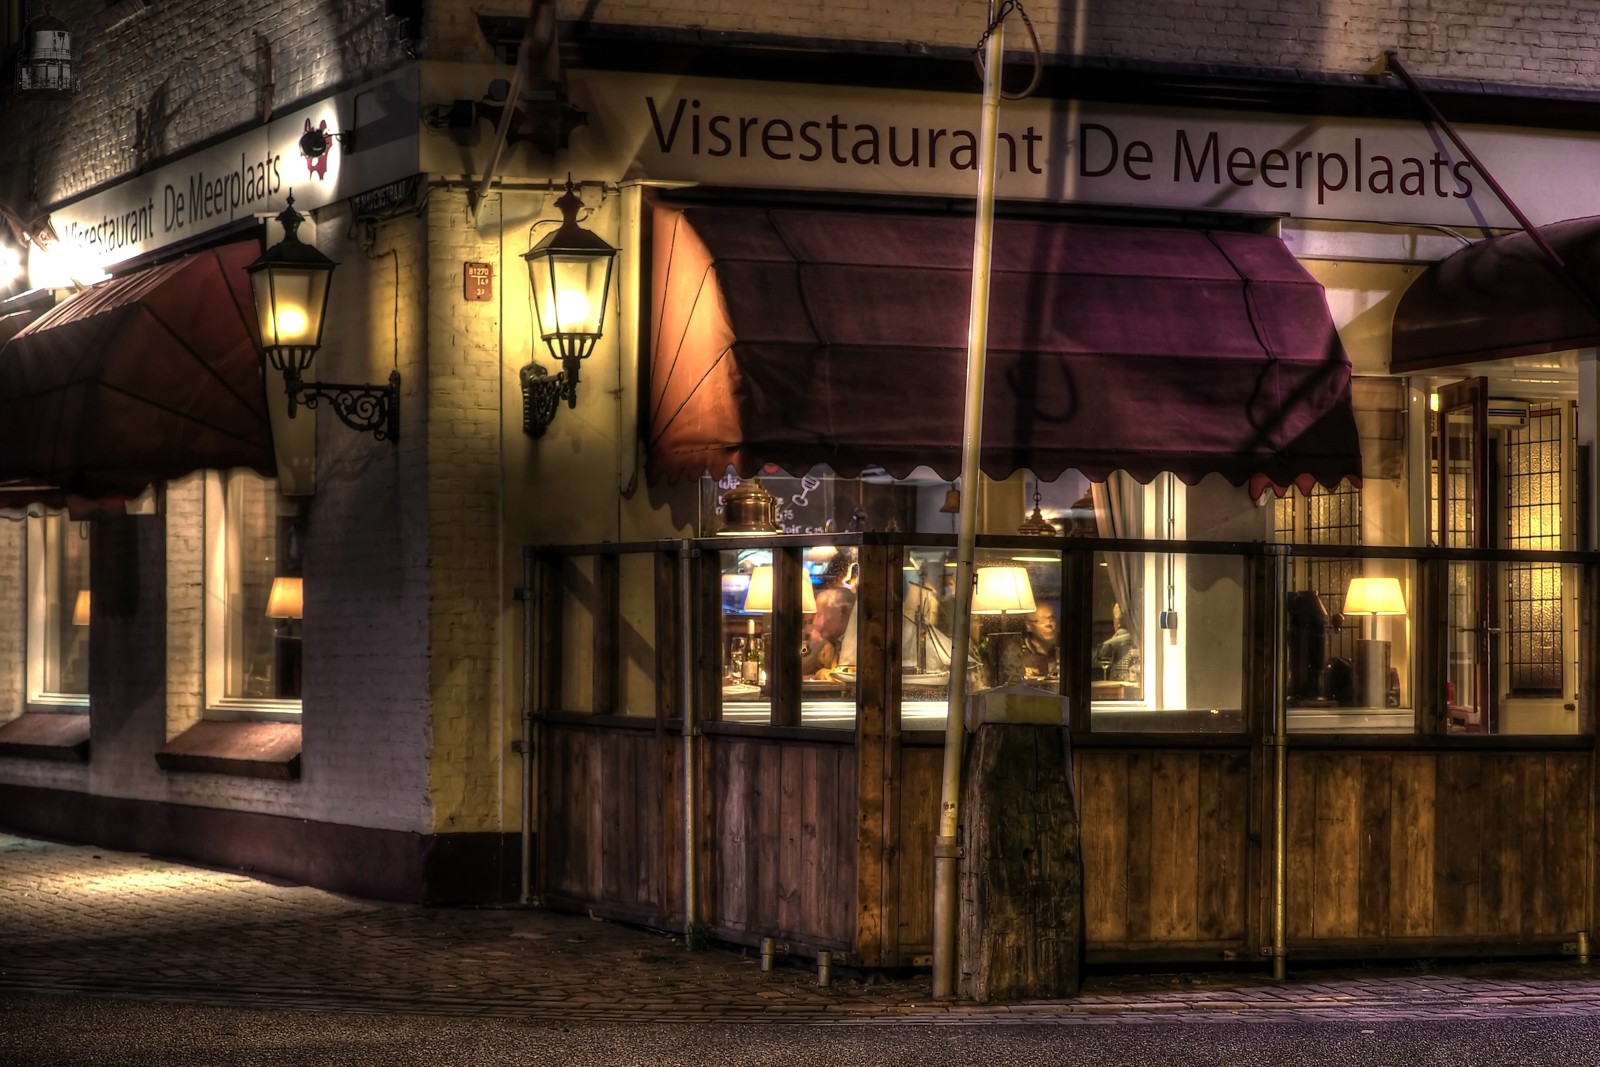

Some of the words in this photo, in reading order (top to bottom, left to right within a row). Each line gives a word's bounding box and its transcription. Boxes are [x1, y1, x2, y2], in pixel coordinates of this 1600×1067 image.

[164, 184, 185, 233] De
[189, 150, 280, 221] Meerplaats
[645, 96, 1042, 175] Visrestaurant
[1079, 122, 1154, 181] De
[1173, 129, 1474, 205] Meerplaats
